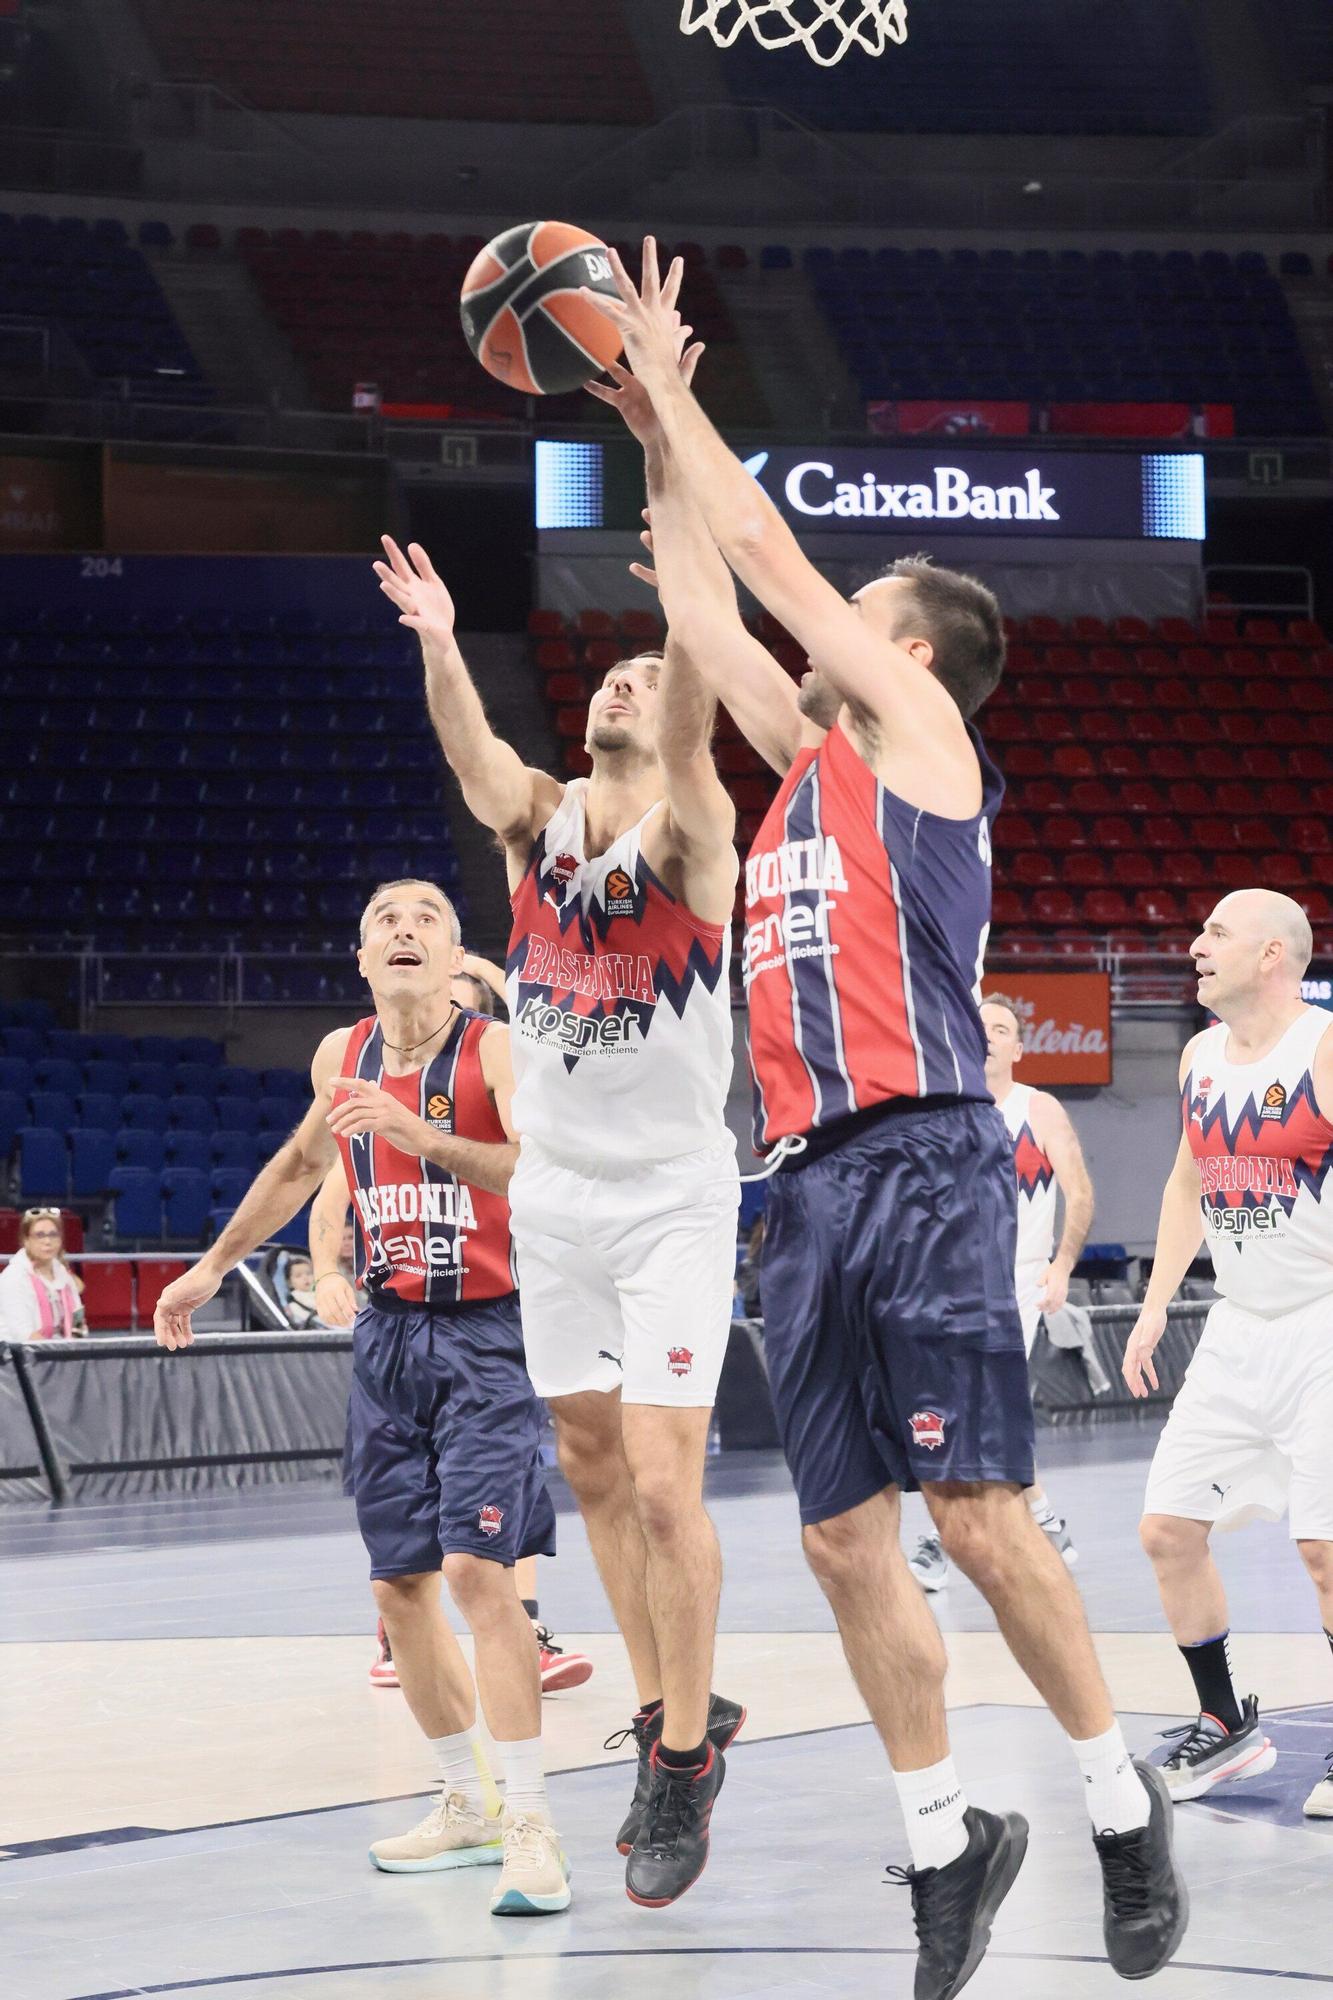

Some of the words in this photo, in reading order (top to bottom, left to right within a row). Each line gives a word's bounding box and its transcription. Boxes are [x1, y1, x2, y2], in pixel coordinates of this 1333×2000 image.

[785, 462, 1060, 520] CaixaBank
[82, 557, 123, 577] 204
[742, 900, 837, 973] osner
[1301, 981, 1332, 1000] TAS
[599, 1046, 640, 1056] eficiente
[1195, 1156, 1299, 1197] ASKONIA
[1209, 1208, 1283, 1230] osner
[368, 1235, 468, 1267] osner
